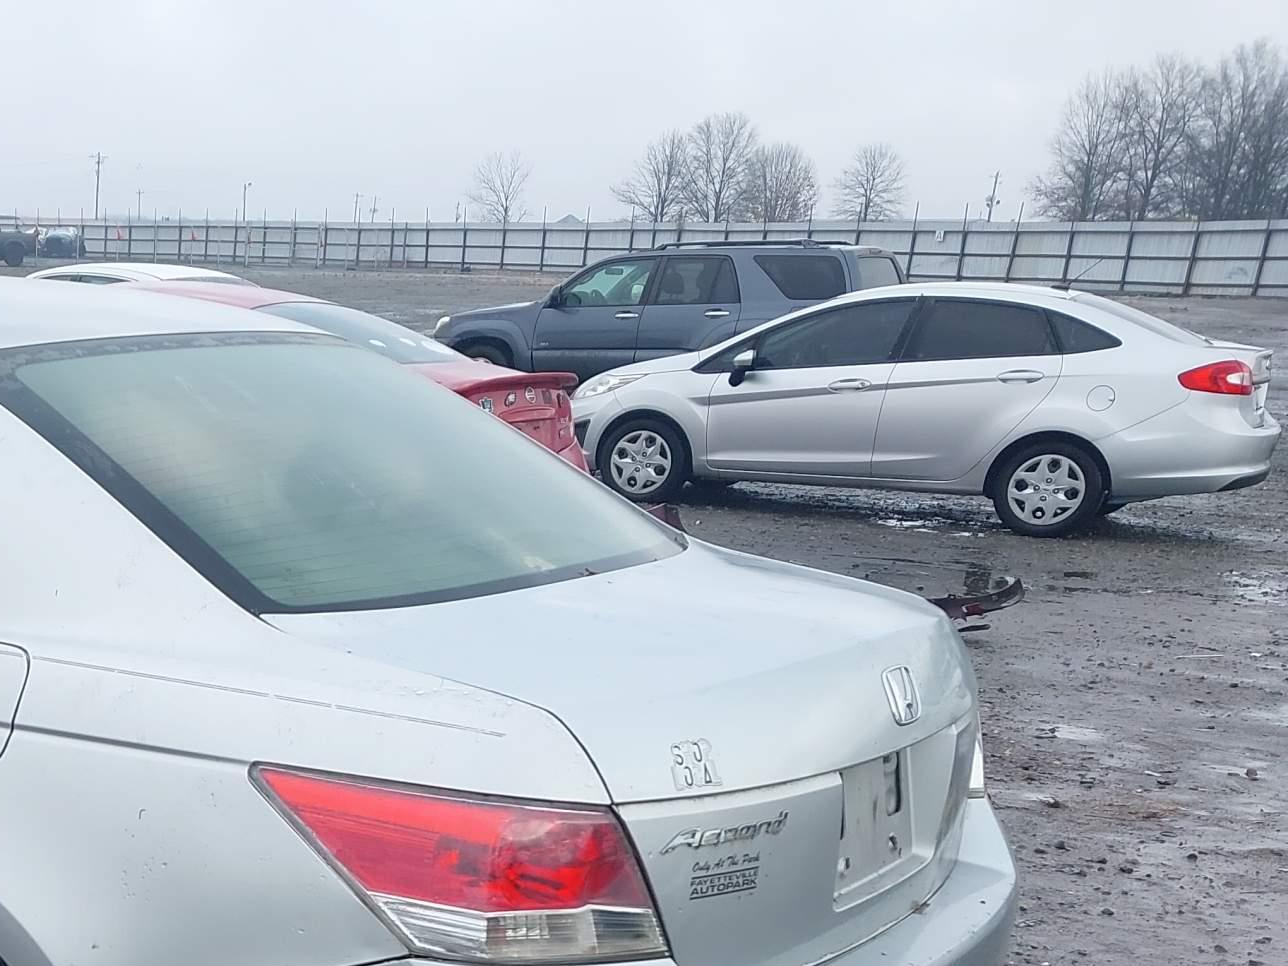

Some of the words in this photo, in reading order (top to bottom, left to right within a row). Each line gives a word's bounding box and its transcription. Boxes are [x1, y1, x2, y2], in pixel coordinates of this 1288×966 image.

[658, 808, 790, 855] Accord
[692, 860, 711, 873] Only
[712, 858, 726, 871] At
[726, 855, 739, 866] The
[690, 869, 759, 887] FAYETTEVILLE
[690, 877, 757, 897] AUTOPARK
